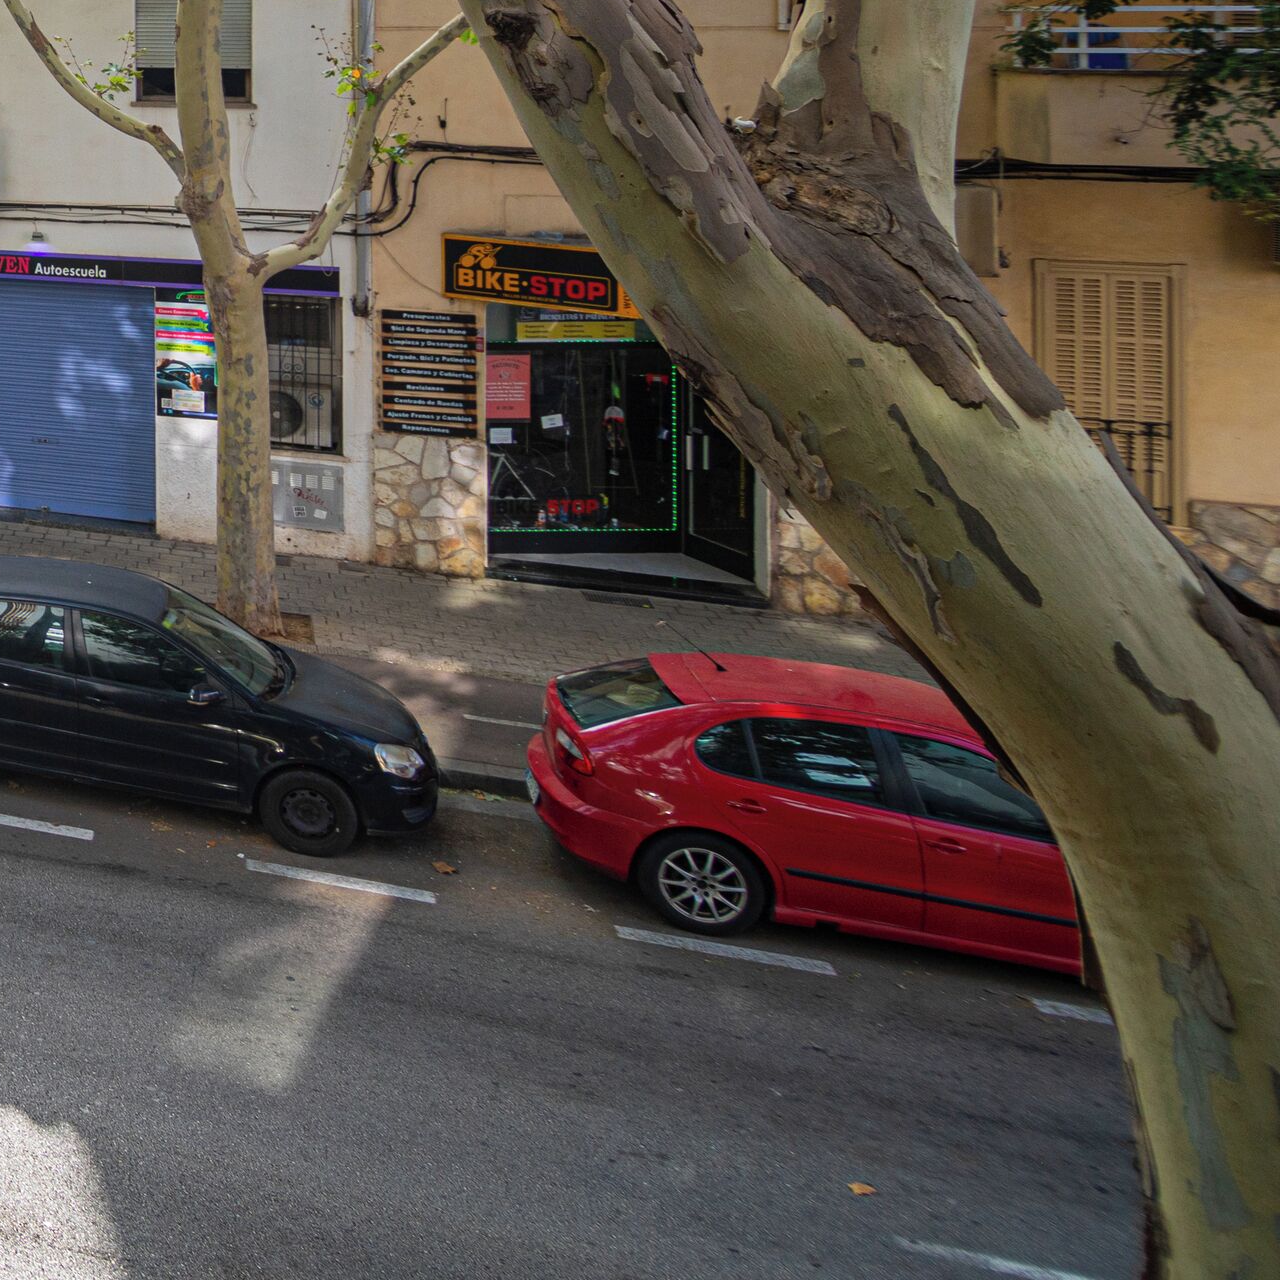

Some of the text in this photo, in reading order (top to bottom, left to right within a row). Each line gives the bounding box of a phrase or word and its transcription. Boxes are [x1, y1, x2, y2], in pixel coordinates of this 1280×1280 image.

[34, 263, 107, 278] Autoescuela
[458, 268, 607, 301] BIKE STOP
[416, 326, 446, 334] Segunda
[388, 338, 420, 346] Limpieza
[441, 355, 476, 364] Patinetes
[439, 370, 474, 379] Cubiertas
[406, 384, 445, 392] Revisiones
[394, 397, 426, 405] Centrado
[436, 400, 464, 408] Ruedas
[442, 414, 473, 422] Cambios
[401, 424, 451, 434] Reparaciones
[547, 499, 599, 514] STOP
